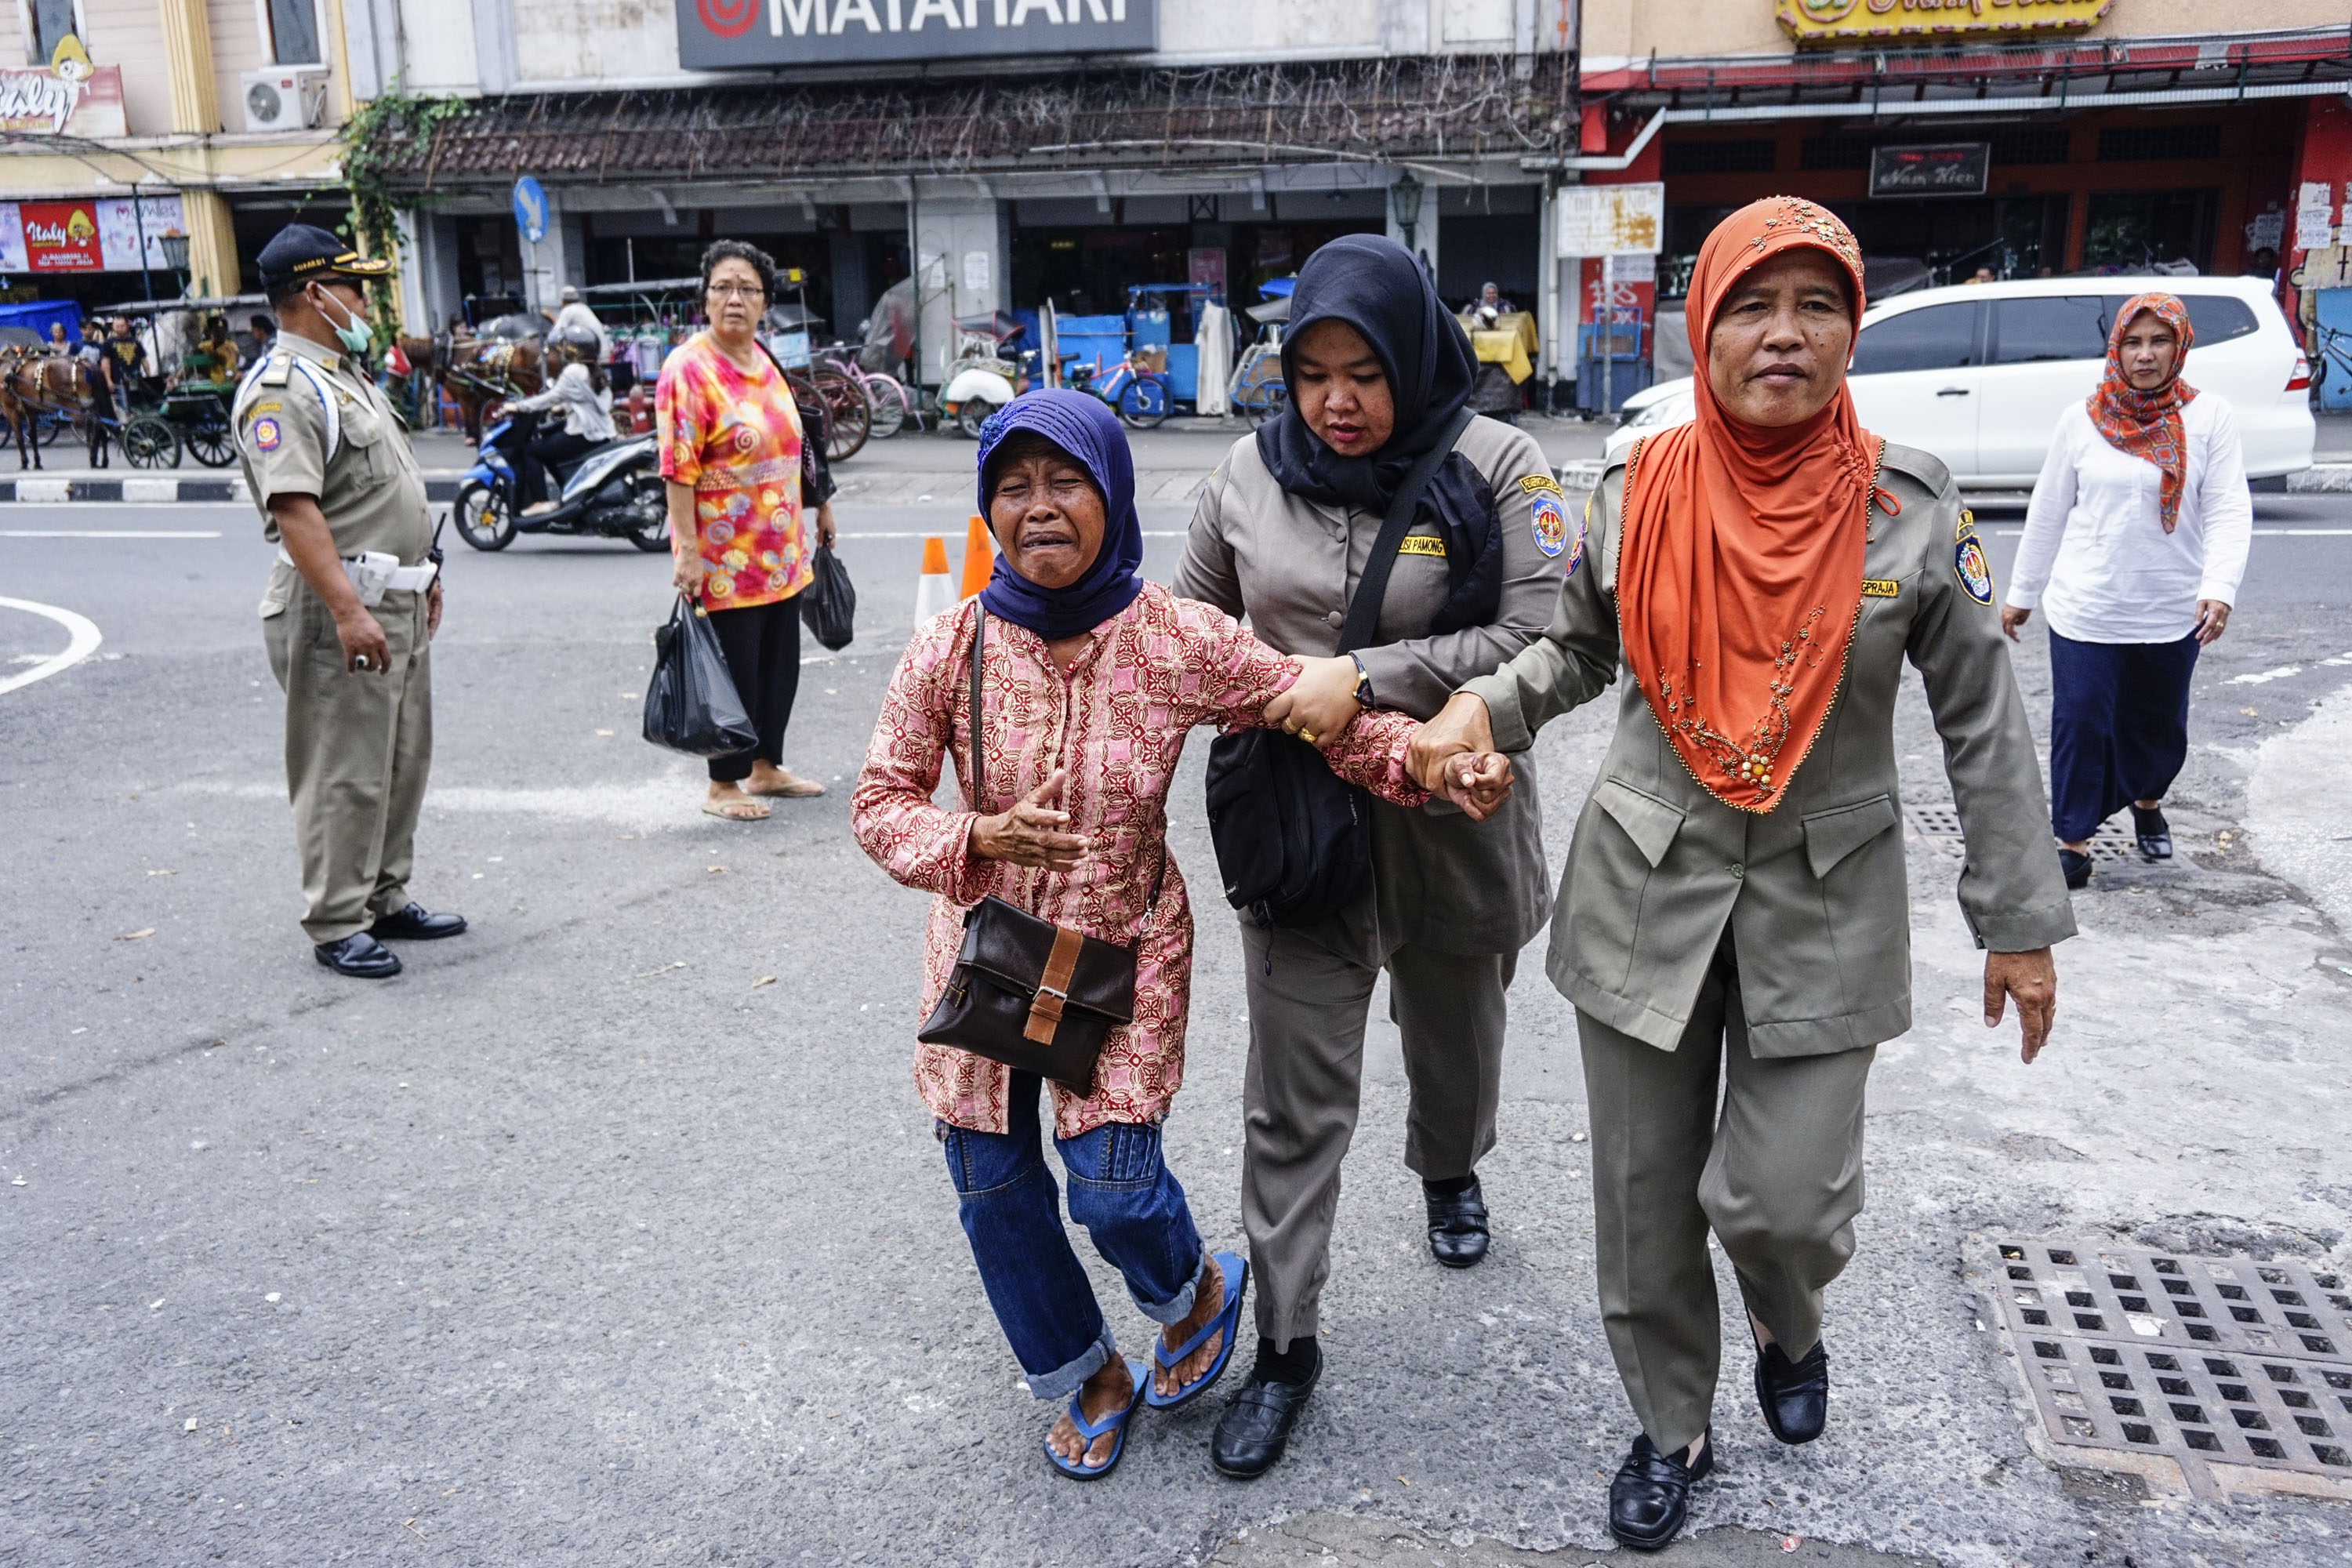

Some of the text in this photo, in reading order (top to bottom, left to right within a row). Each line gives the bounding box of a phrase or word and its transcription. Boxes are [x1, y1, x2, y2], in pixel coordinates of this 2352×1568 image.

[0, 74, 69, 134] aly
[26, 220, 67, 249] Italy
[1412, 538, 1443, 554] PAMONG
